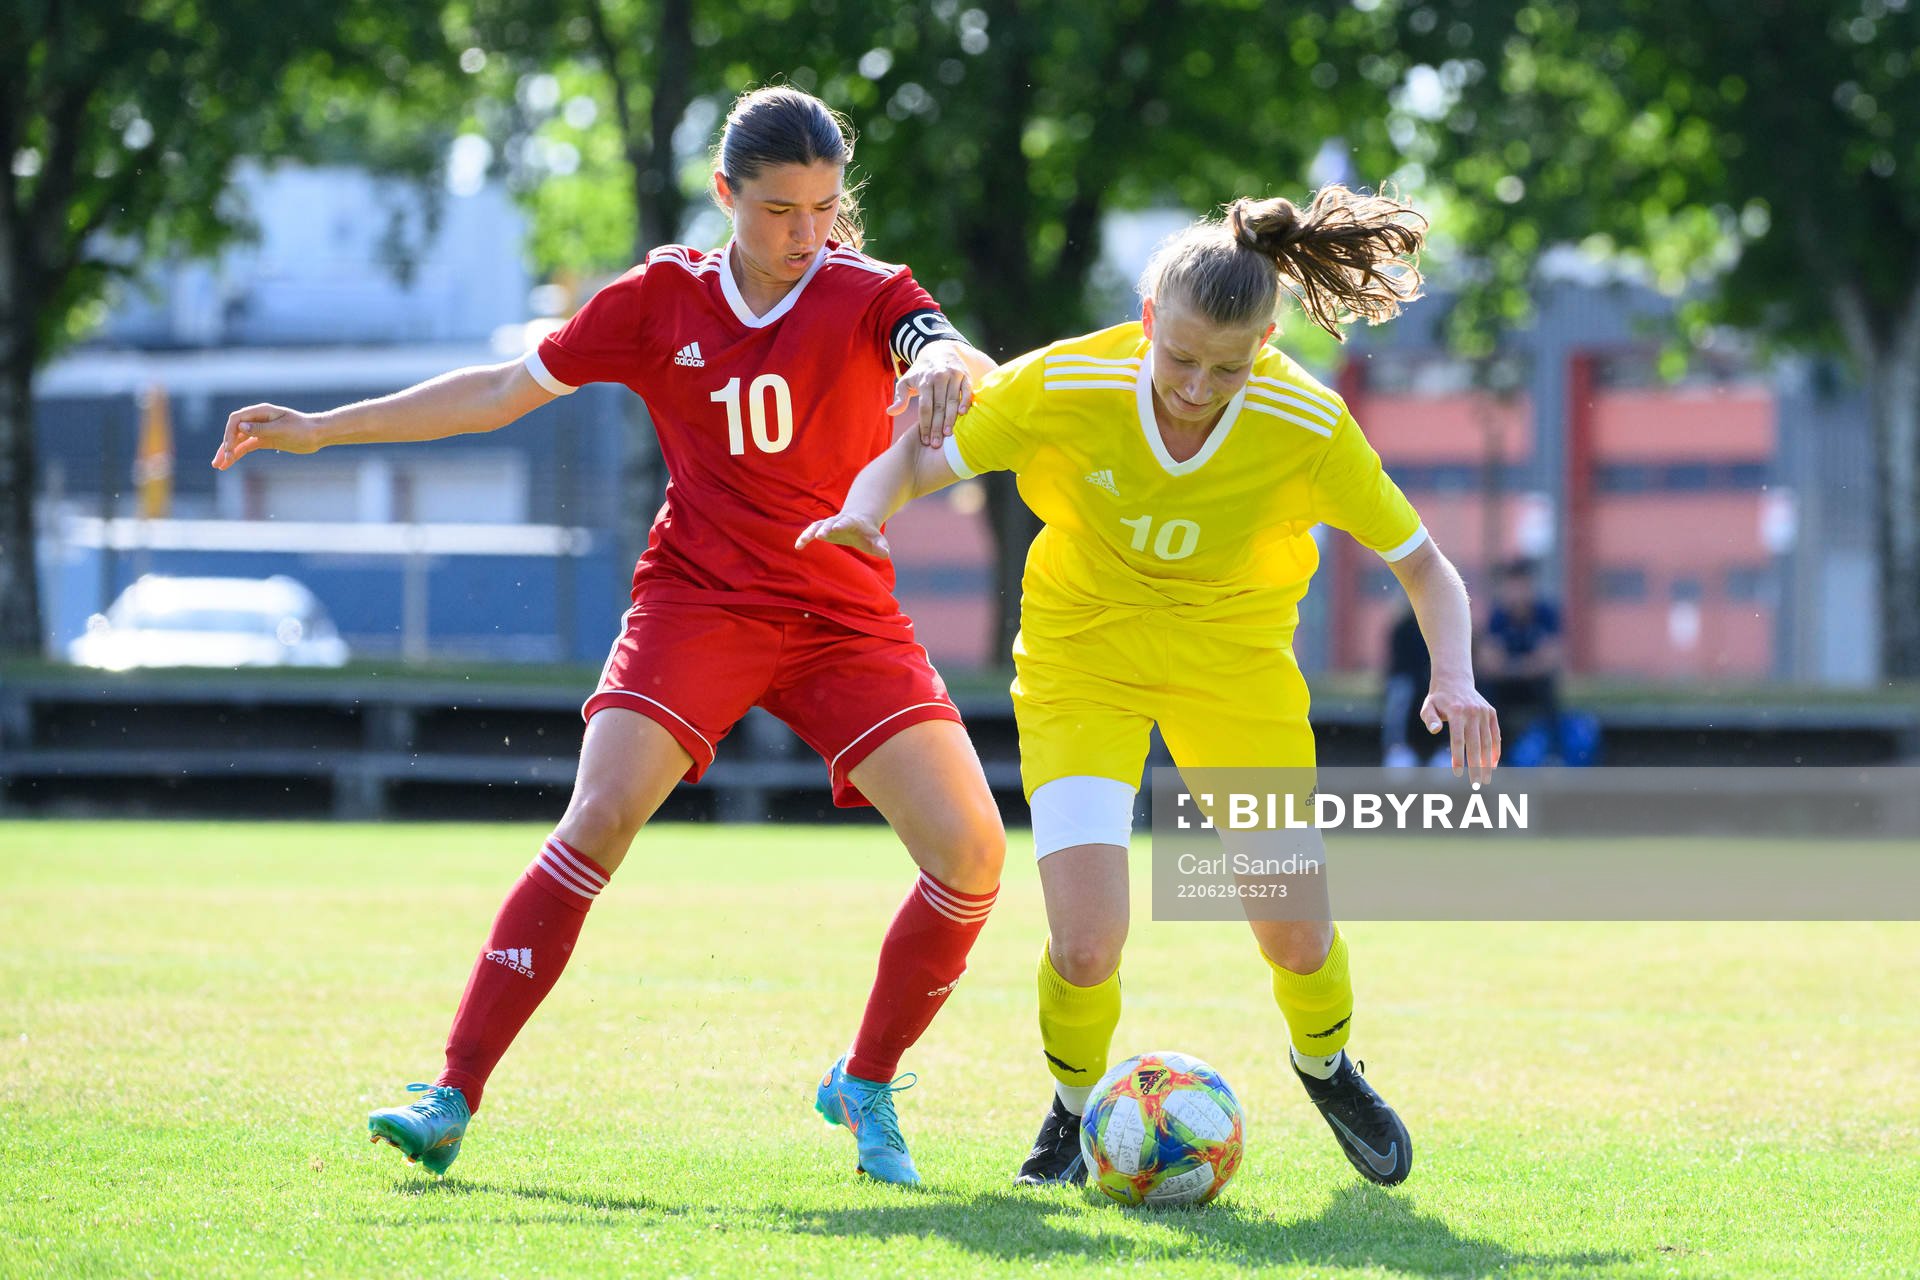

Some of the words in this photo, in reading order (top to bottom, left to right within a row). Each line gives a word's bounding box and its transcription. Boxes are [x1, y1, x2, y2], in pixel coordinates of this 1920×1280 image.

[674, 356, 705, 367] adidas
[710, 373, 793, 455] 10
[1119, 515, 1200, 560] 10
[485, 952, 535, 979] adidas
[1143, 1069, 1167, 1095] adidas
